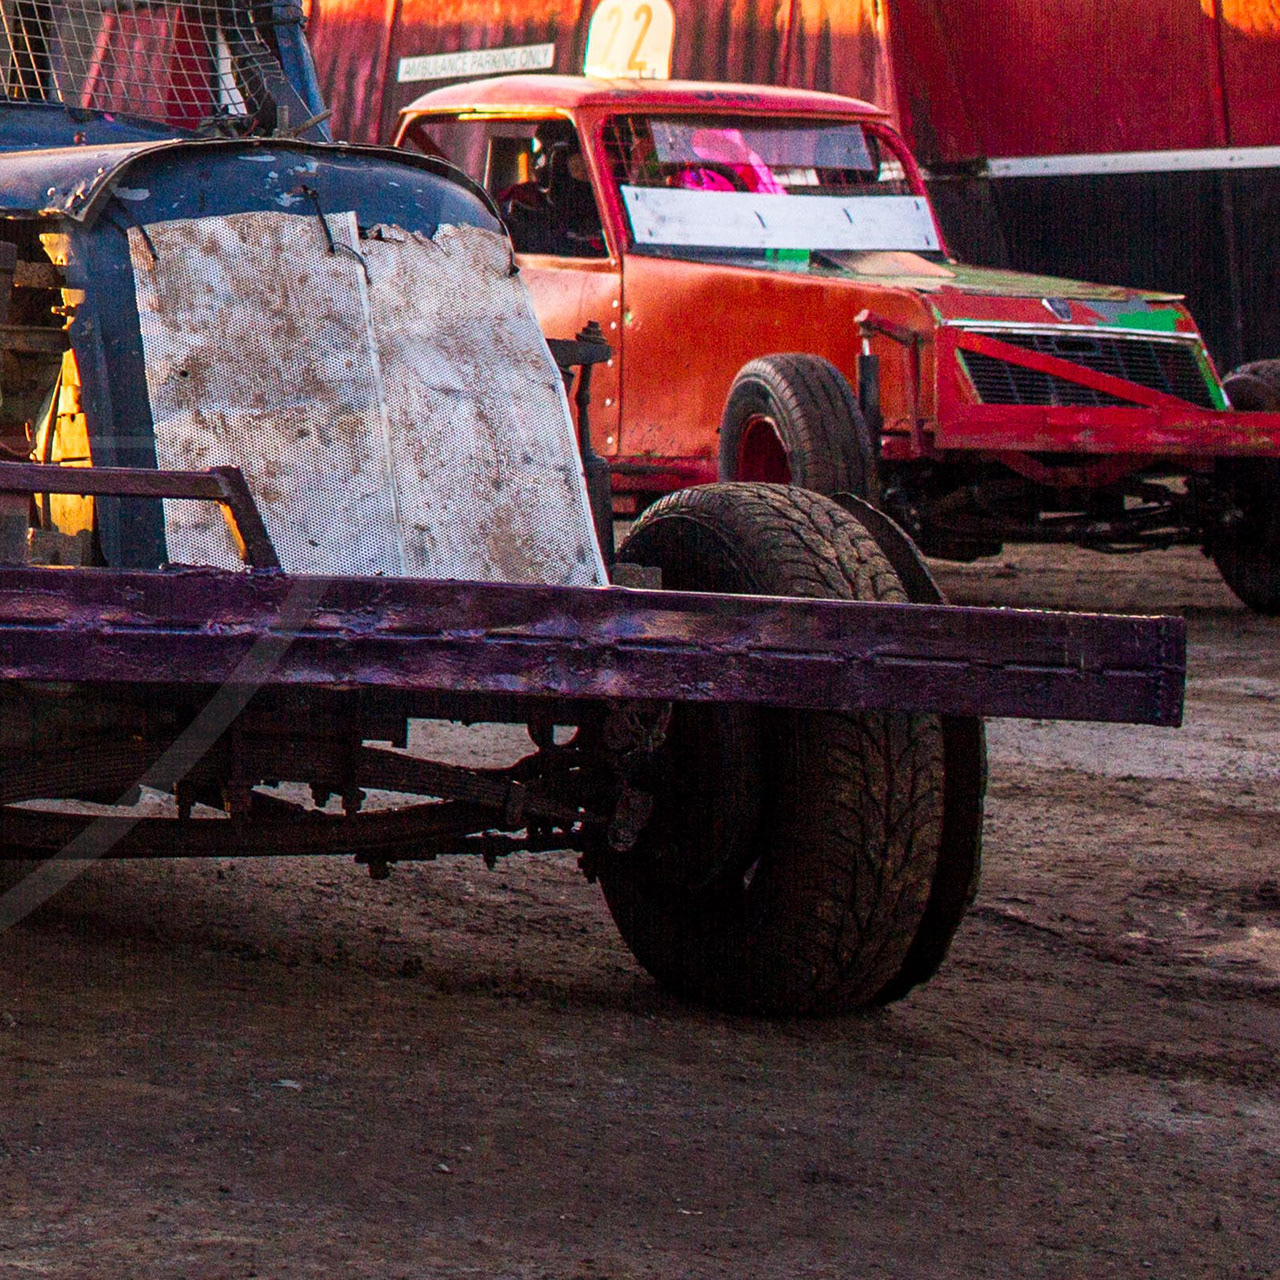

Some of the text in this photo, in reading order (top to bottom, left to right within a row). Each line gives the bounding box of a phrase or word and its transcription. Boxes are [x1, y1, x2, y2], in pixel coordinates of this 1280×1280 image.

[403, 48, 550, 77] AMBULANCE PARKING ONLY
